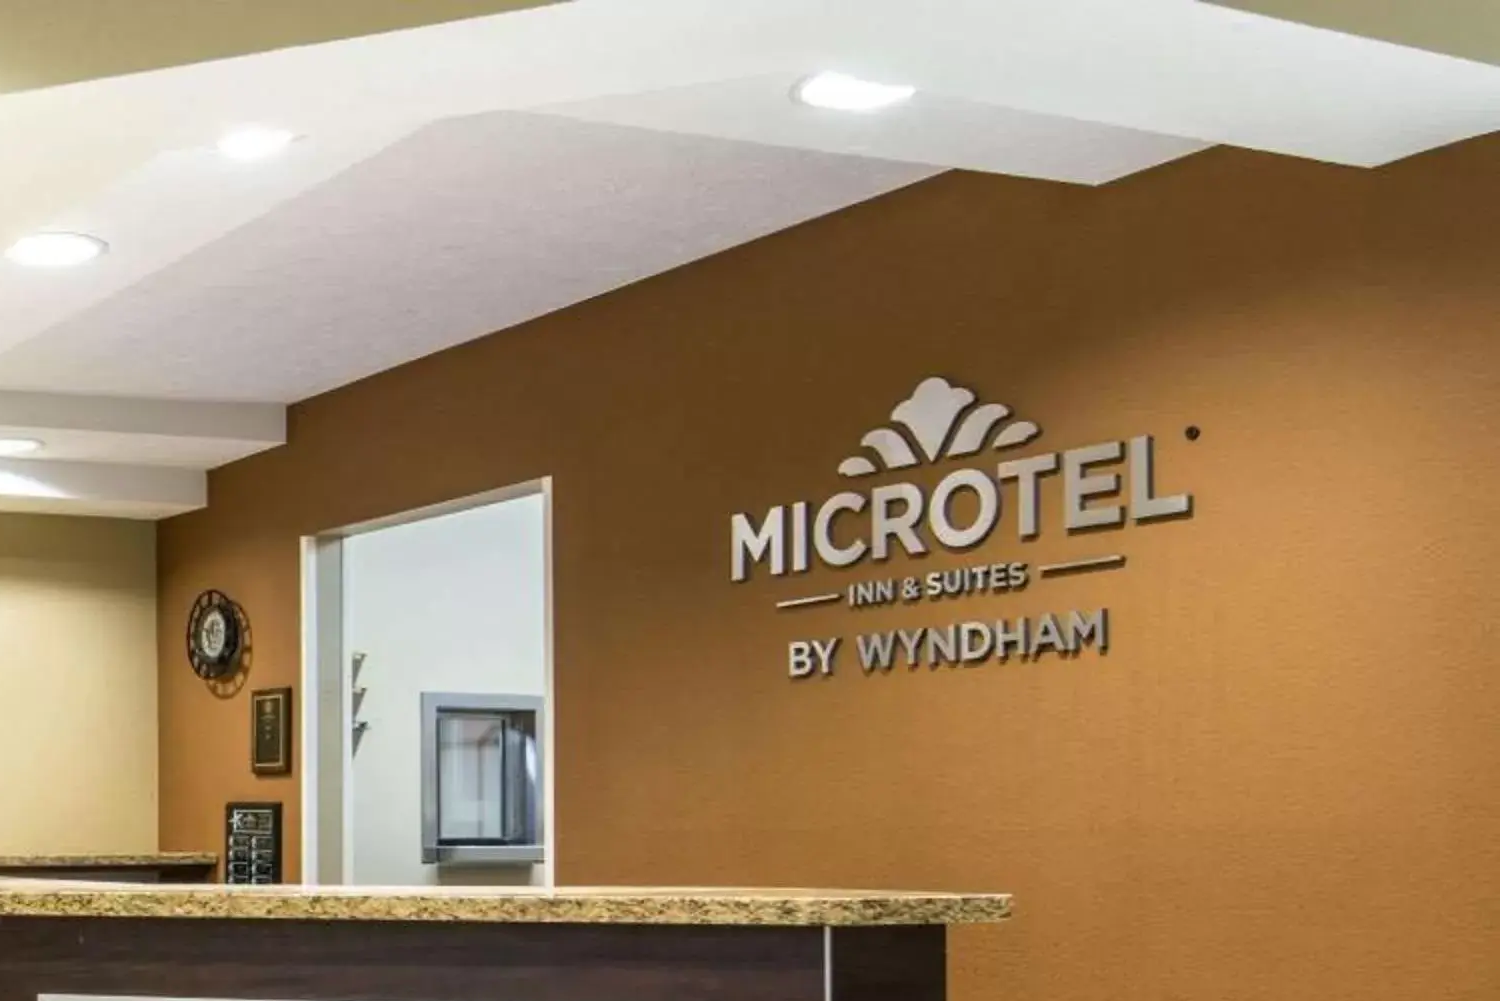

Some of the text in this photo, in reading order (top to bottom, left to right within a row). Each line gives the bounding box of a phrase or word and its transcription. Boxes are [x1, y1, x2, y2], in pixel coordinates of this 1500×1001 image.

[730, 434, 1192, 581] MICROTEL
[848, 562, 1028, 607] INN & SUITES
[788, 607, 1108, 678] BY WYNDHAM
